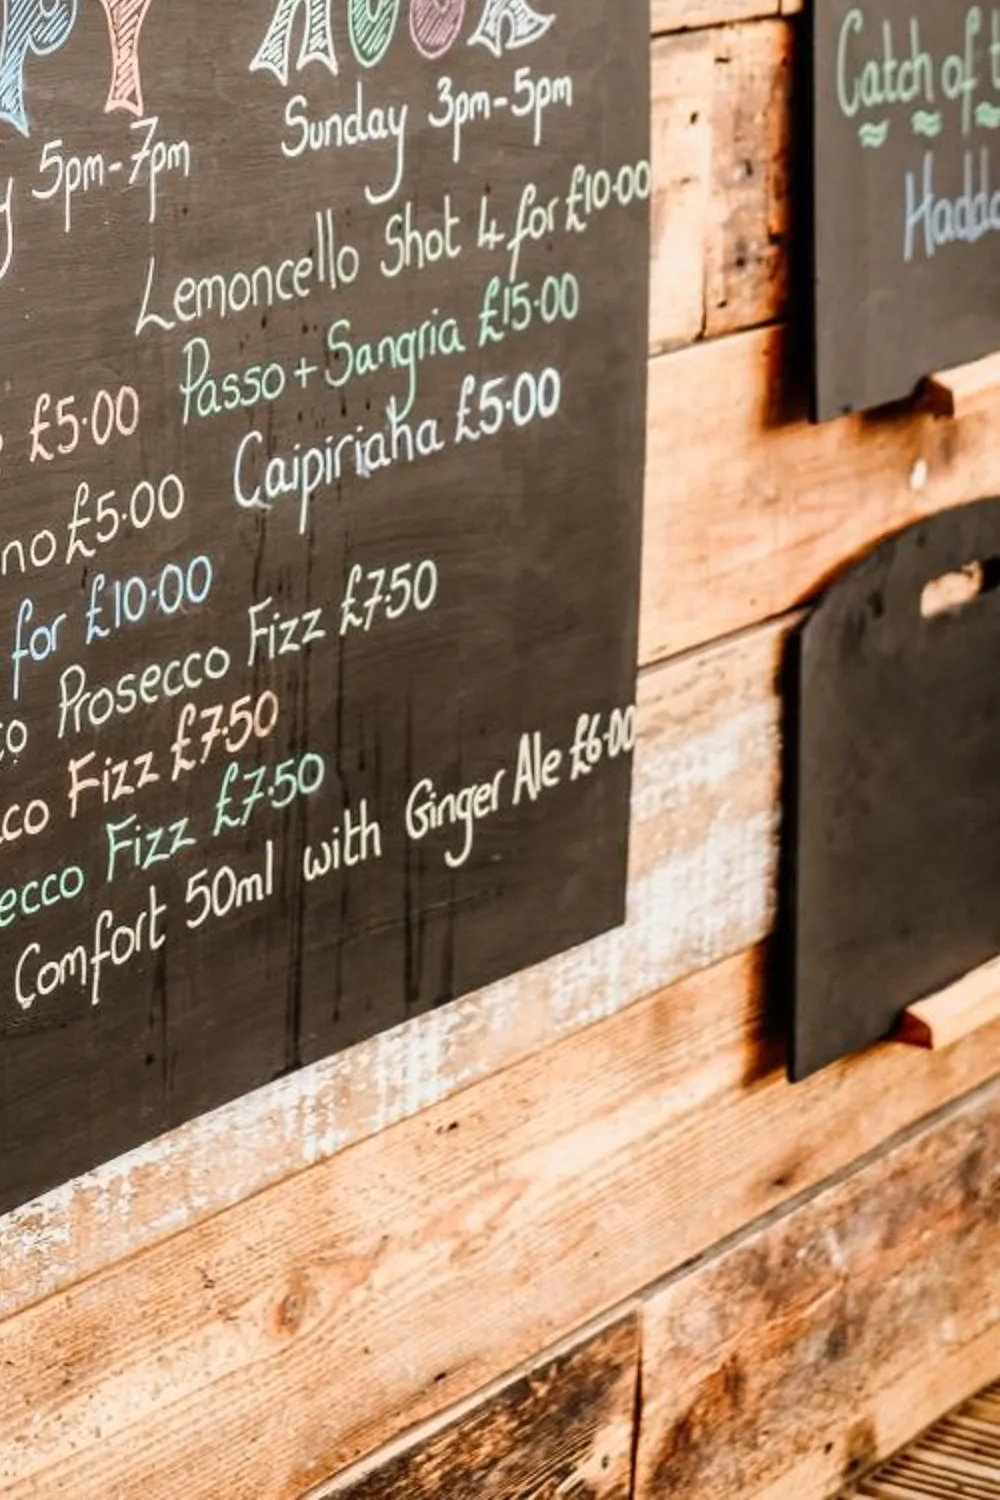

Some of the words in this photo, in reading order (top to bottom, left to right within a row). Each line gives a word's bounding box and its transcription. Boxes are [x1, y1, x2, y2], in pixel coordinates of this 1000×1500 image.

[836, 7, 936, 118] Catch
[940, 3, 983, 138] of
[281, 80, 409, 205] Sunday
[135, 208, 359, 336] Lemoncello
[380, 195, 462, 278] Shot
[477, 195, 504, 251] 4
[507, 183, 563, 284] for
[180, 337, 286, 426] Passo
[293, 356, 319, 391] +
[324, 319, 467, 423] Sangria
[11, 598, 67, 702] for
[57, 645, 231, 740] Prosecco
[246, 594, 327, 668] Fizz
[66, 750, 160, 818] Fizz
[14, 883, 168, 1006] Comfort
[184, 838, 275, 930] 50ml
[302, 797, 383, 883] with
[404, 766, 507, 869] Ginger
[511, 729, 562, 806] Ale
[104, 813, 197, 883] Fizz
